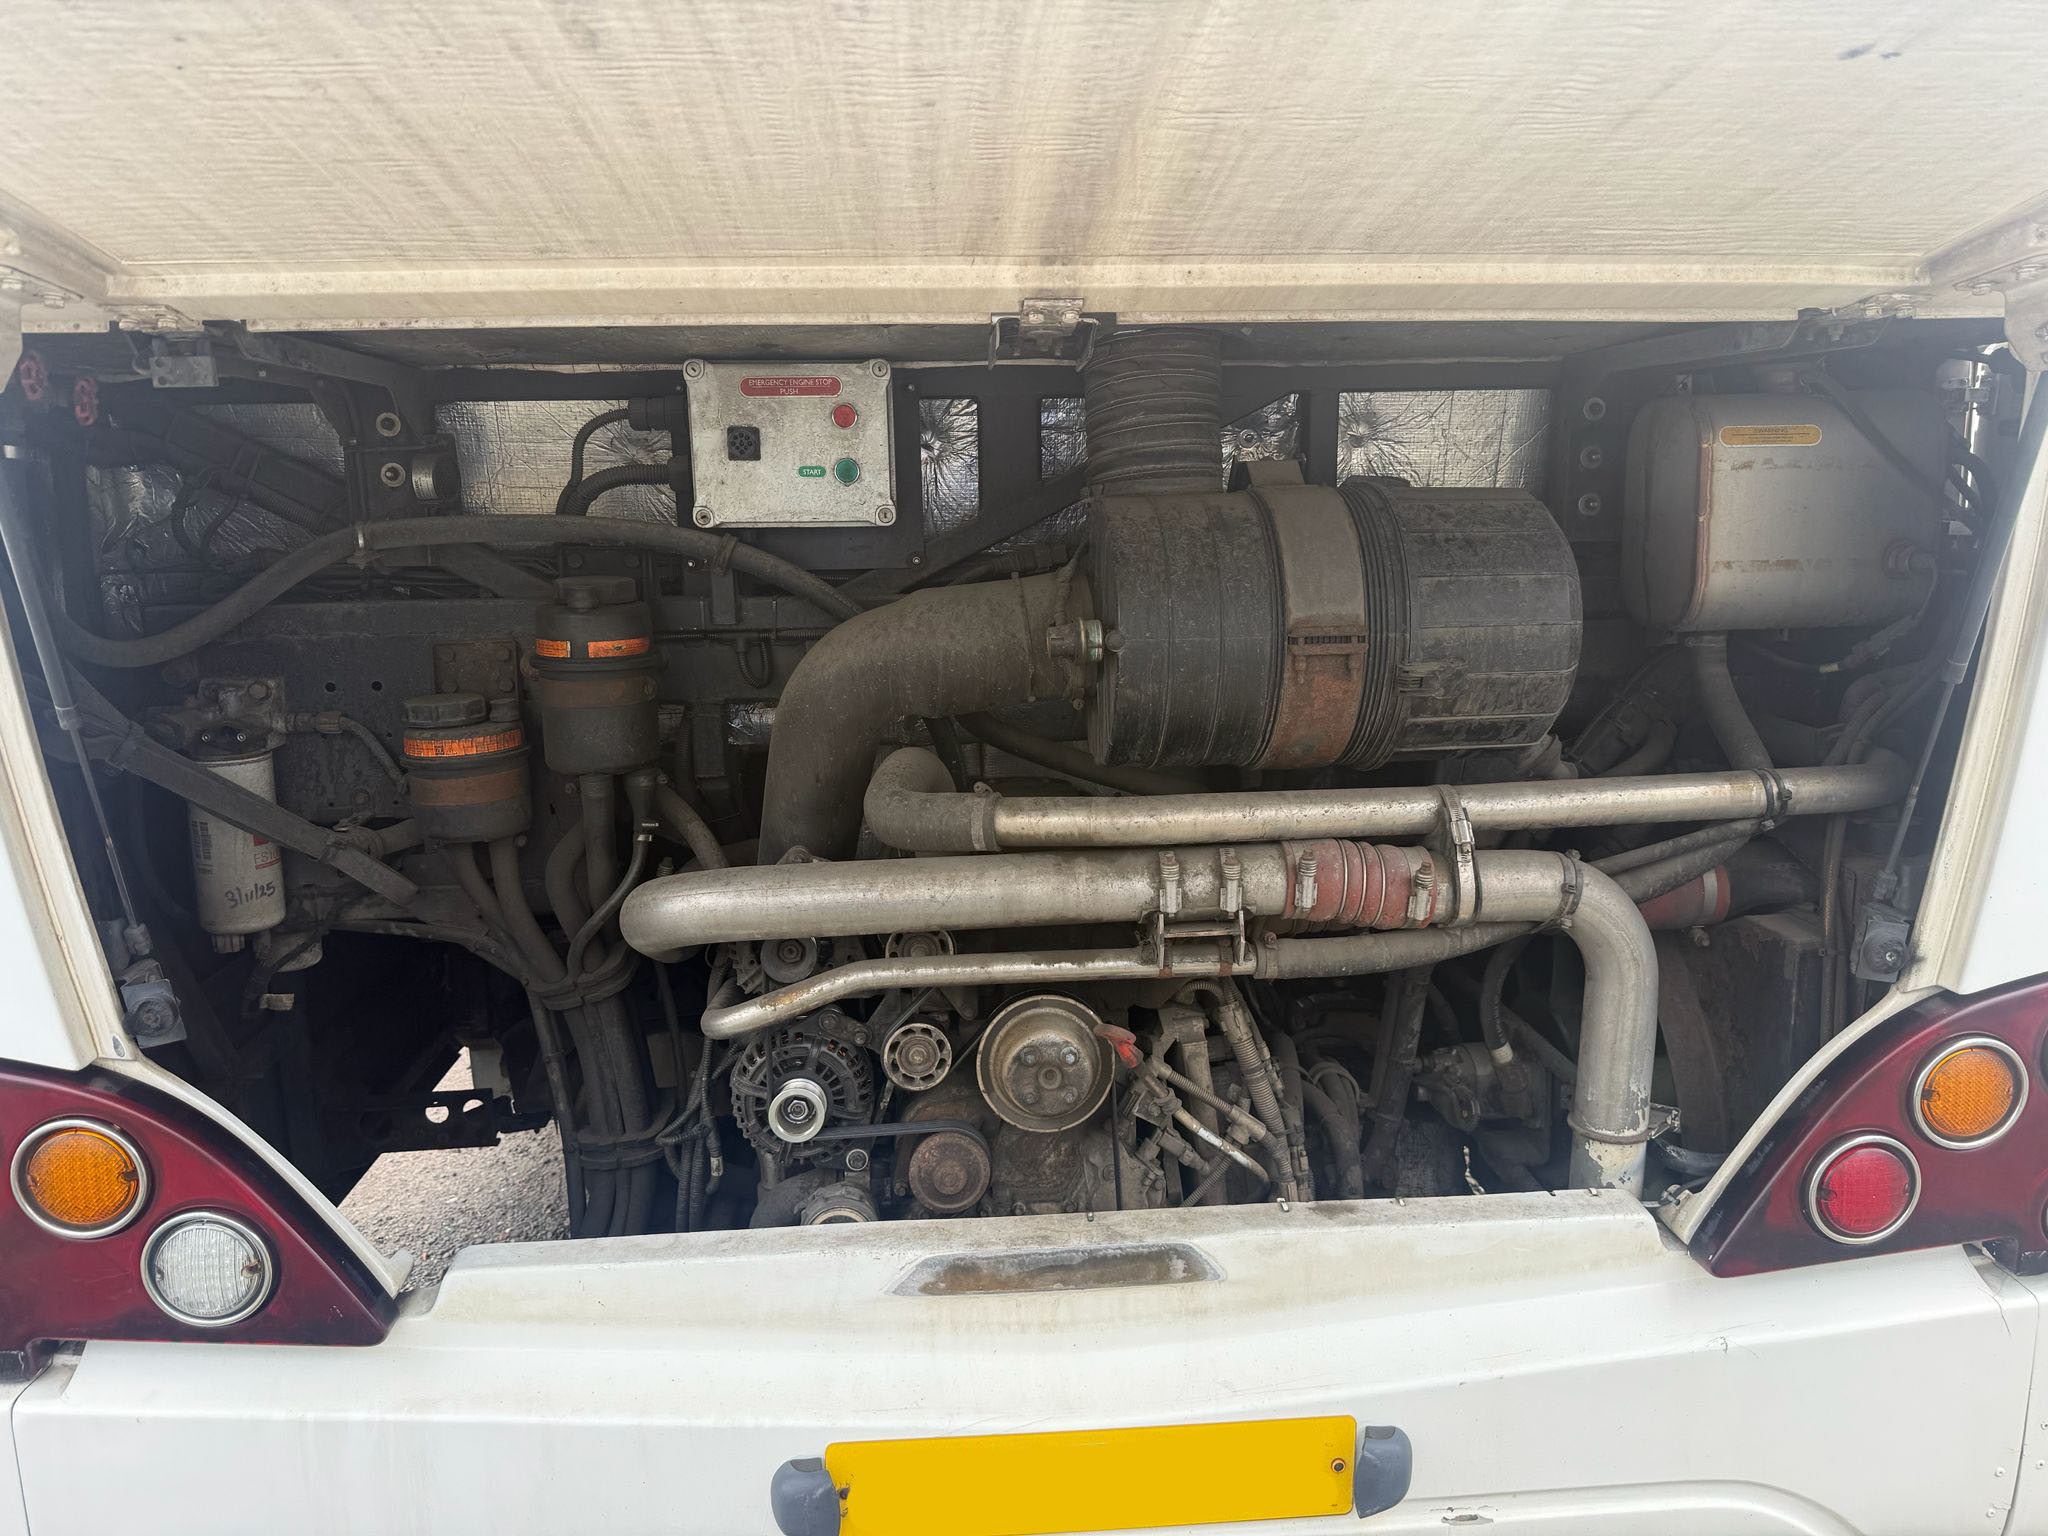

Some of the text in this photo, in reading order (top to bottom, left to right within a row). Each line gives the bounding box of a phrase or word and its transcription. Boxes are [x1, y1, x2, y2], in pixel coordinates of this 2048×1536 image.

[748, 378, 832, 386] EMERGENCY ENGINE STOP
[779, 387, 799, 395] PUSH
